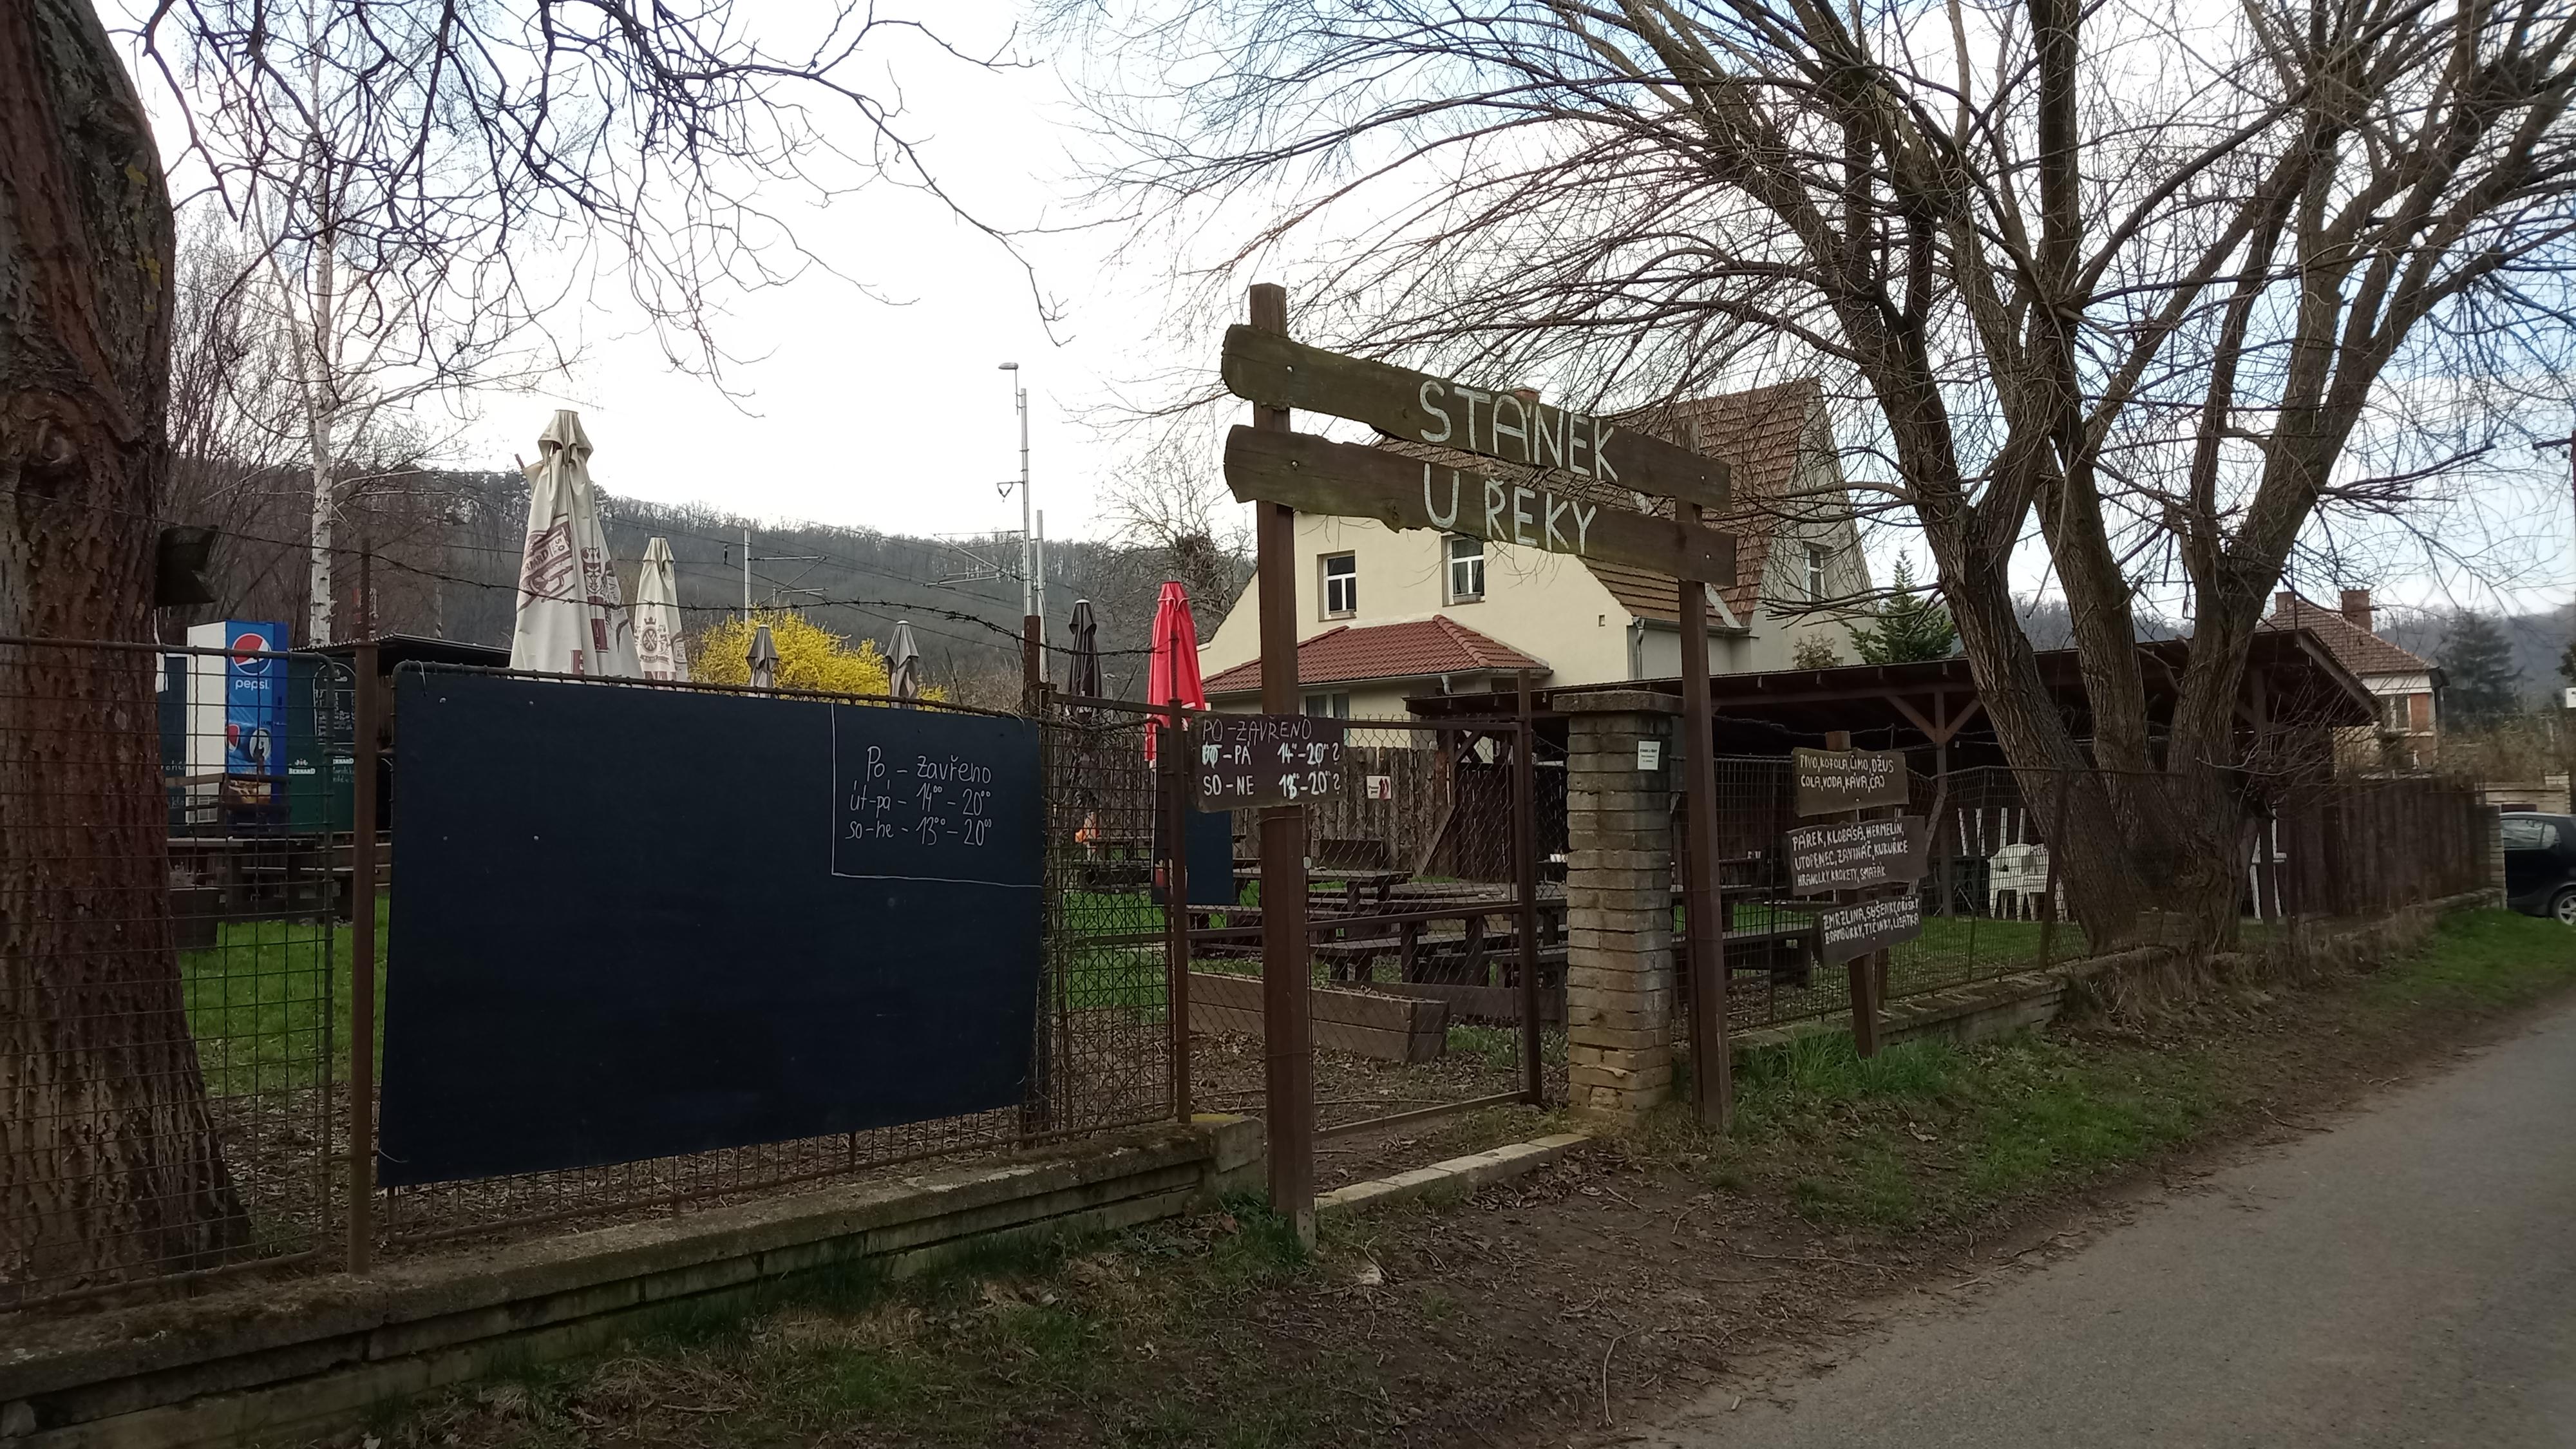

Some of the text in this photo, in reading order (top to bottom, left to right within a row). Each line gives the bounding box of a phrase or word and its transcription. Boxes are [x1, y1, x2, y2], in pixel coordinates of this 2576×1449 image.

[1419, 380, 1618, 482] STÁNEK
[1424, 463, 1596, 554] U ŘEKY
[235, 679, 268, 691] pepsi
[867, 746, 886, 781] Po
